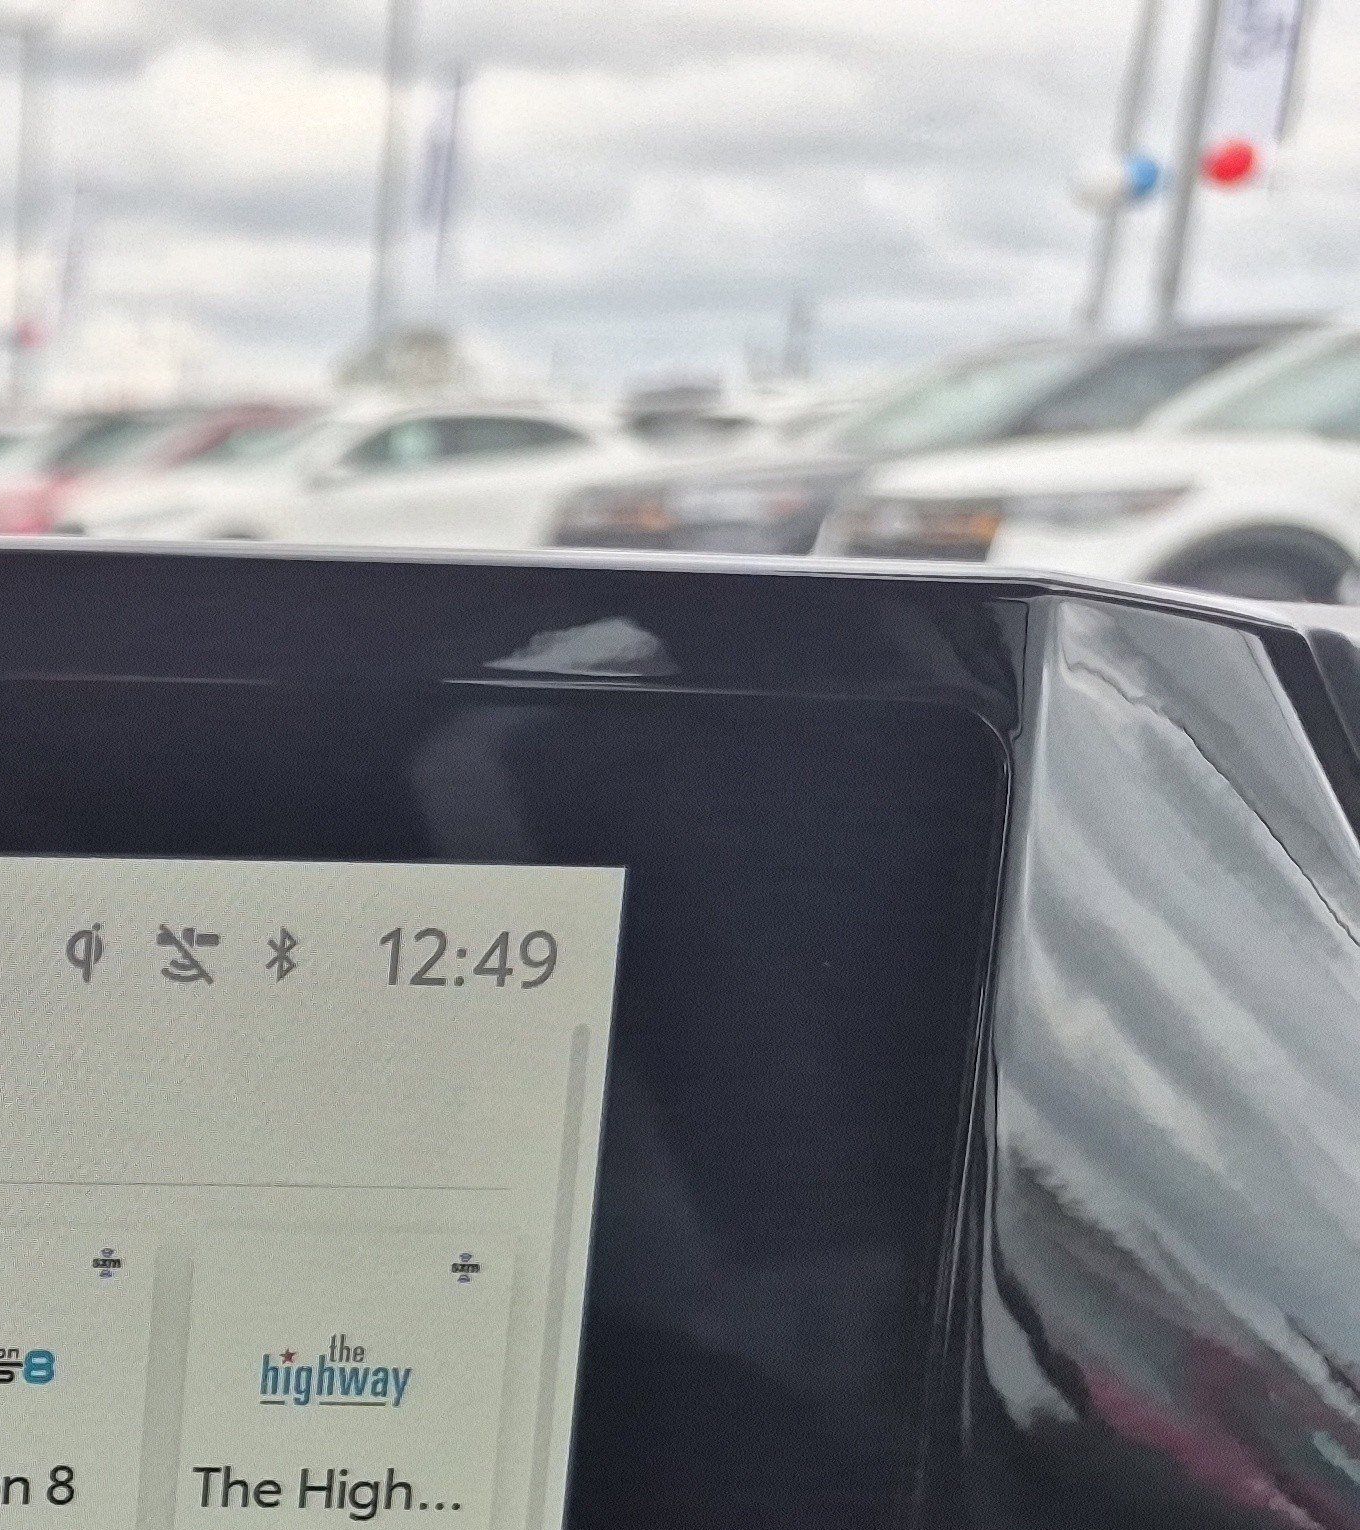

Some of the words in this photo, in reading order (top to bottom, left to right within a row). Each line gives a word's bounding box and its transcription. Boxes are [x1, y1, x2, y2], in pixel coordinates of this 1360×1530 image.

[380, 927, 558, 990] 12:49
[329, 1334, 365, 1363] the
[260, 1354, 412, 1406] highway
[46, 1465, 75, 1505] 8
[192, 1465, 281, 1508] The
[298, 1468, 461, 1521] High...
